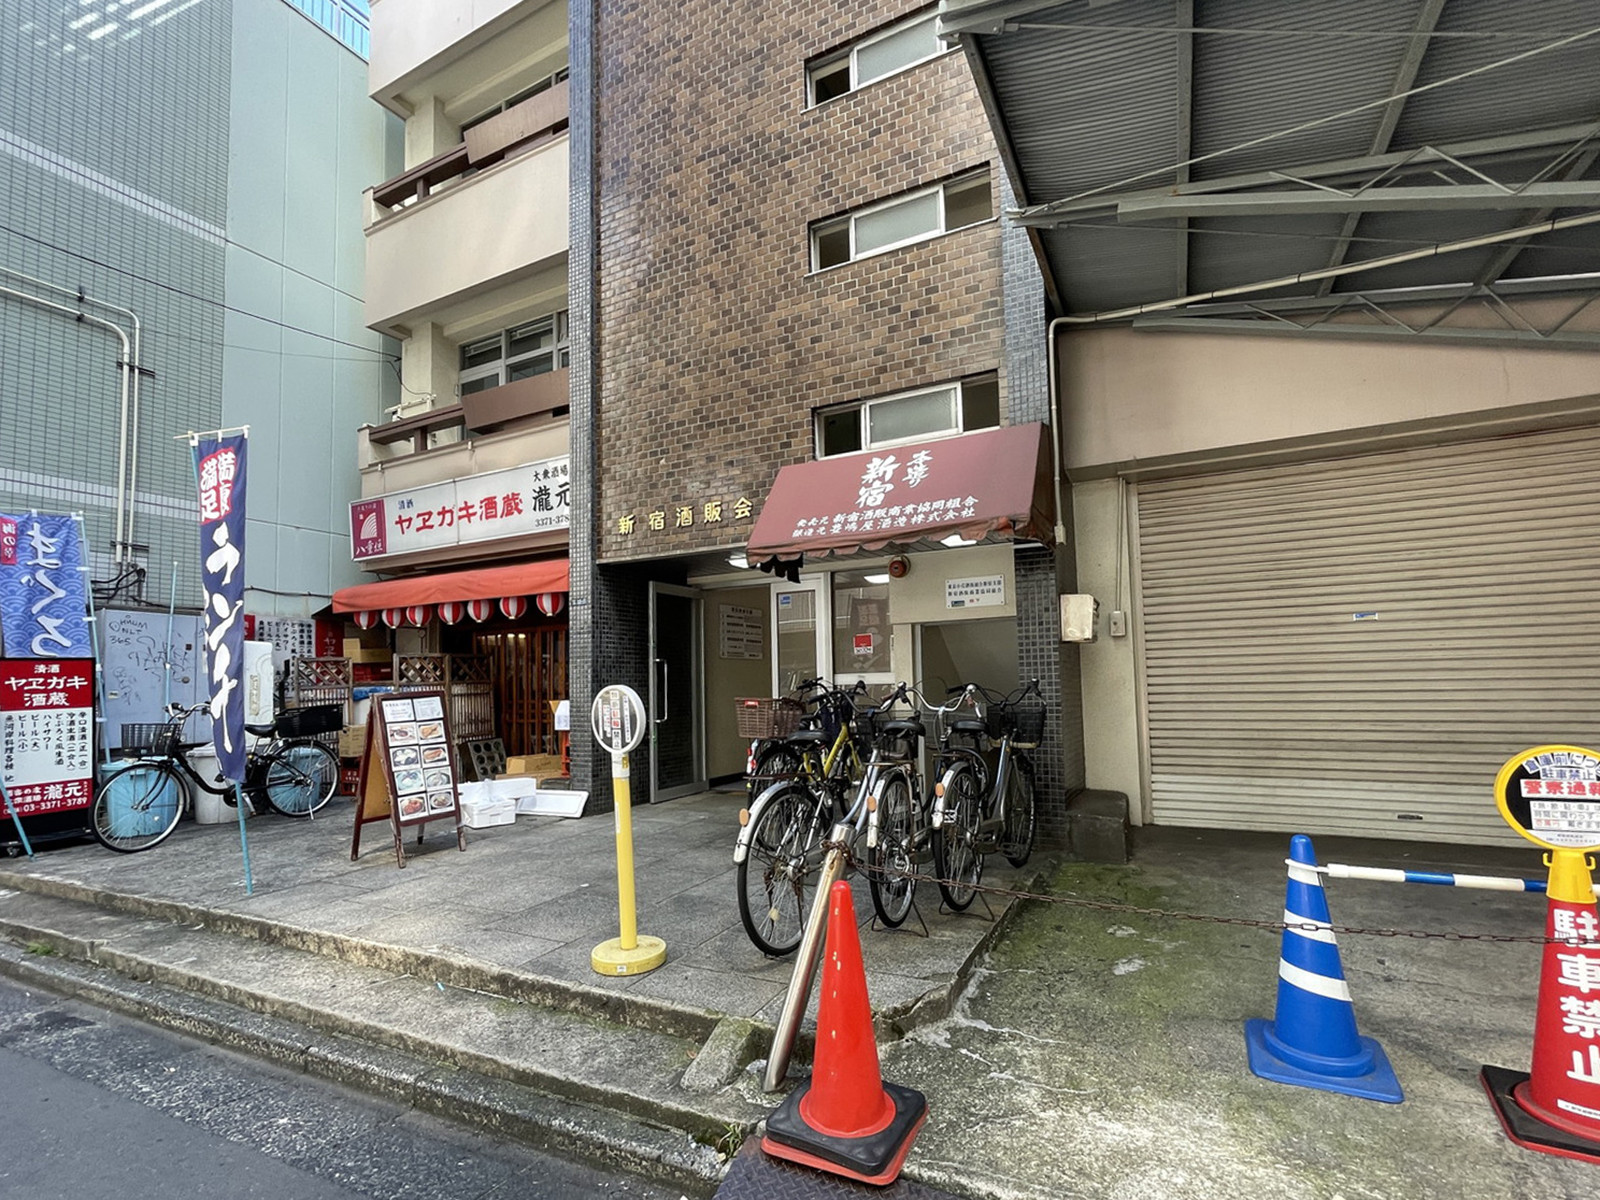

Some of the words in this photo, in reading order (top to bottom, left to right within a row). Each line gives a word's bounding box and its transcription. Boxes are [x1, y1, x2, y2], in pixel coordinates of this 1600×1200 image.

[533, 464, 568, 482] 大衆酒場
[855, 455, 902, 508] 新宿
[201, 458, 220, 522] 満足
[532, 481, 570, 512] 瀧元
[394, 492, 523, 535] ヤヱガキ酒蔵
[618, 496, 769, 534] 新宿酒販会
[20, 522, 72, 657] まぐろ
[4, 676, 88, 691] ヤヱガキ
[23, 693, 70, 707] 酒蔵
[43, 714, 52, 750] ハイサワー
[1541, 766, 1595, 780] 駐車禁止
[23, 797, 88, 812] 03-3371-3789
[43, 782, 83, 800] 瀧元
[1553, 908, 1600, 1085] 駐車禁止
